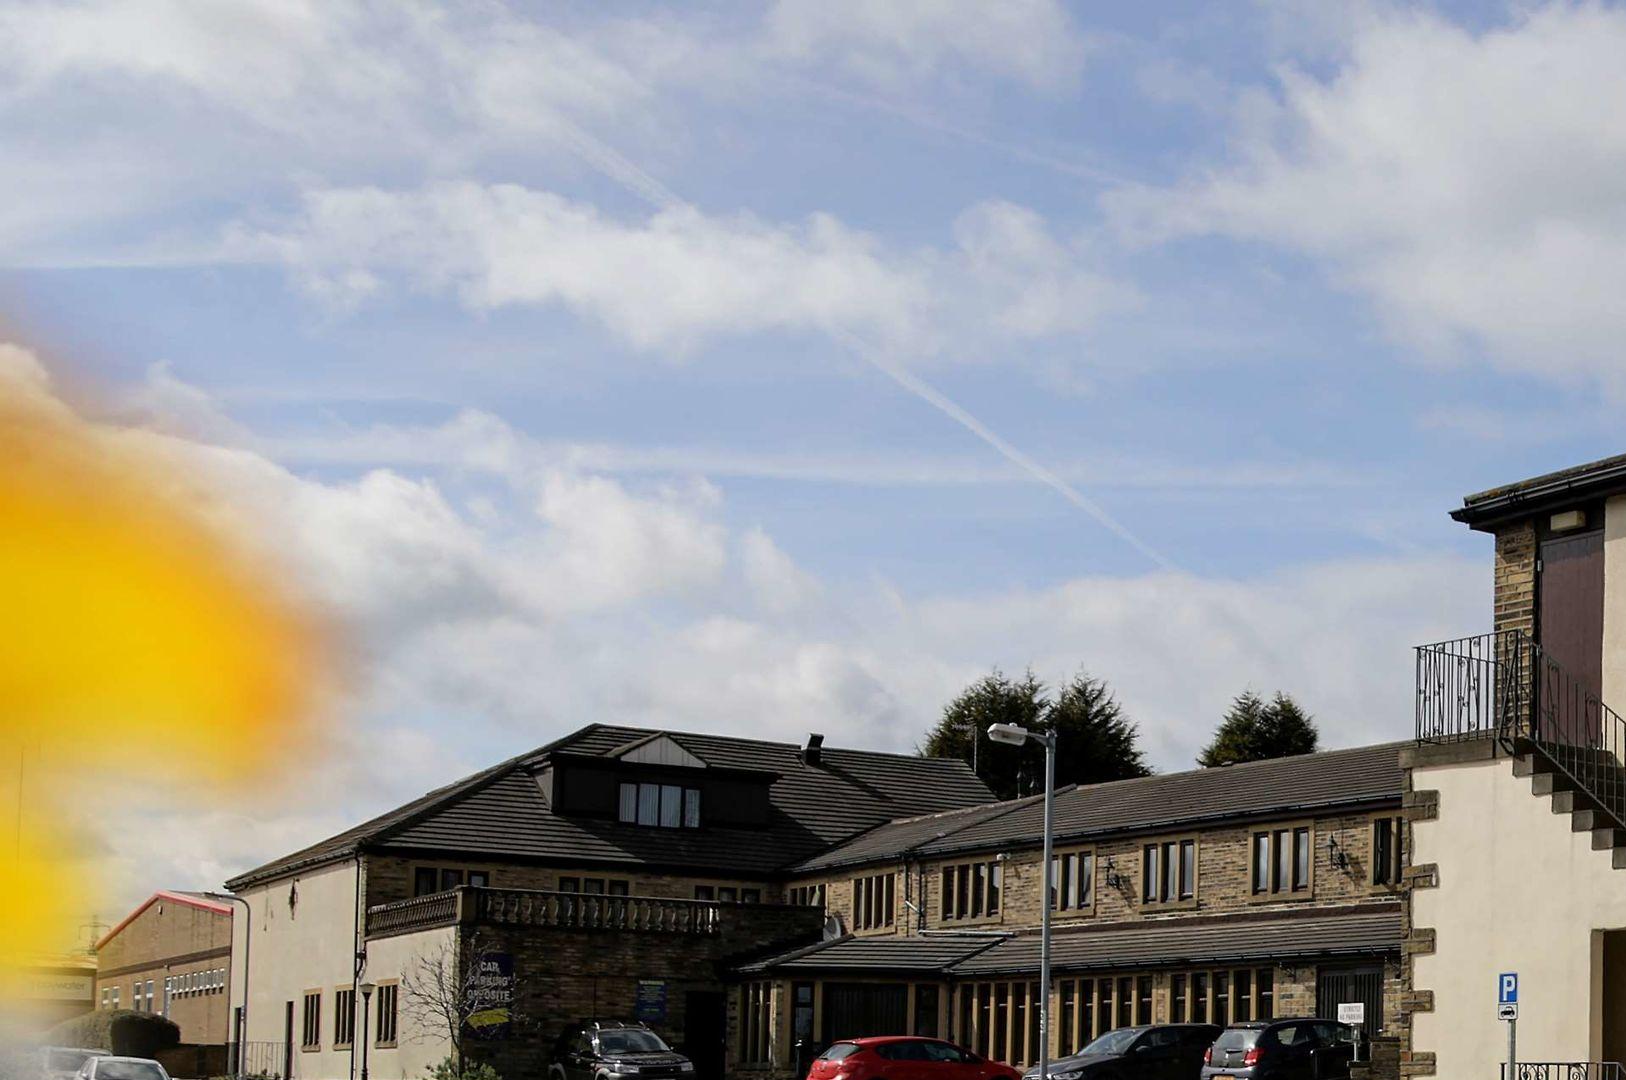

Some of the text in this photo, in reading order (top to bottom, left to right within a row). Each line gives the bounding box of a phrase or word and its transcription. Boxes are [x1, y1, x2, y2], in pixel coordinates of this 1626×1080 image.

[480, 961, 500, 972] CAR
[1503, 975, 1516, 1001] P
[467, 989, 510, 1001] OPPOSITE
